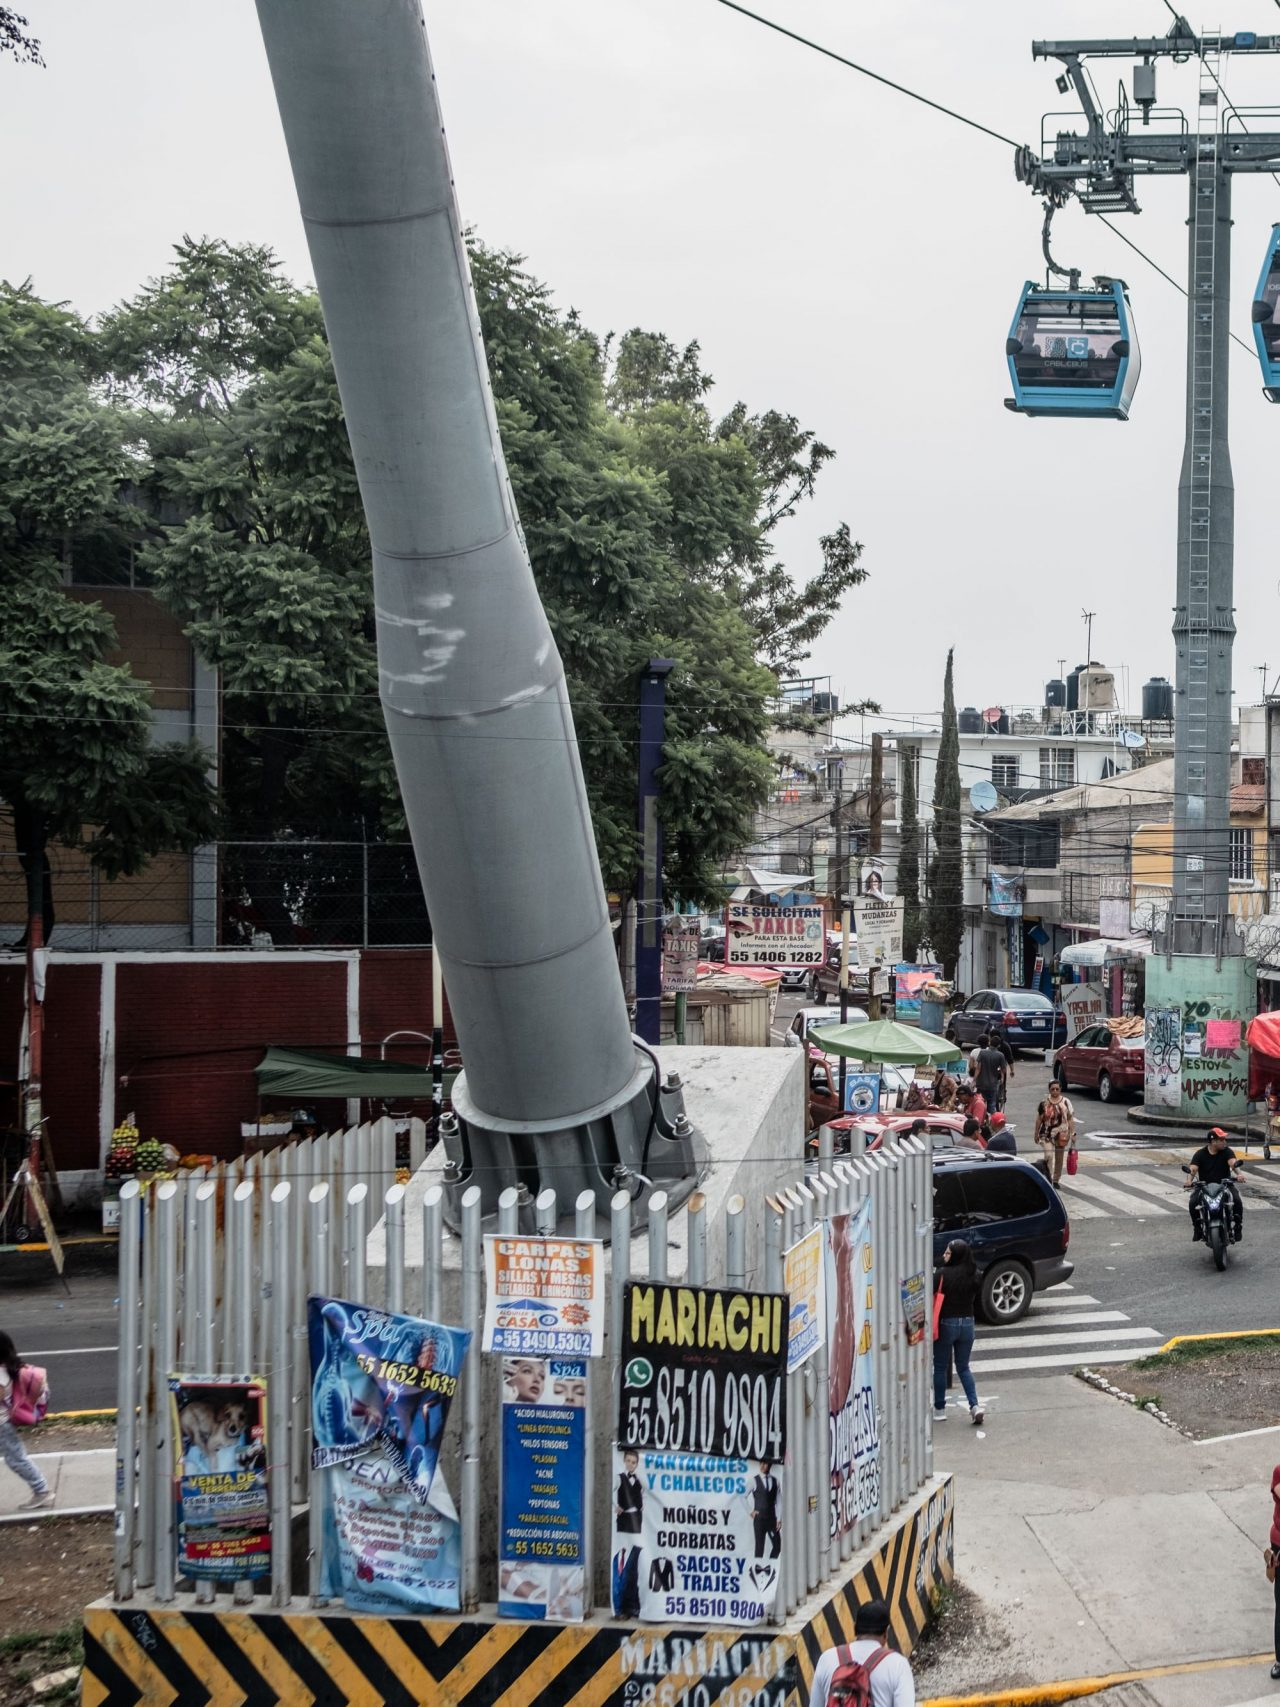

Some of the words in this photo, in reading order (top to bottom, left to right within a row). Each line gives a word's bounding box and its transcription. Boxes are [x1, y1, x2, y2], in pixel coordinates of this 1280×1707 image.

[732, 906, 748, 918] SE
[752, 906, 820, 918] SOLICITAN
[862, 910, 897, 920] MUDANZAS
[752, 918, 806, 934] TAXIS
[667, 940, 698, 952] TAXIS
[730, 951, 749, 962] 55
[753, 951, 786, 962] 1406
[790, 952, 822, 962] 1282
[1186, 1060, 1222, 1070] ESTOY
[849, 1076, 878, 1088] BASE
[498, 1243, 590, 1258] CARPAS
[508, 1256, 580, 1272] LONAS
[498, 1270, 538, 1283] SILLAS
[540, 1271, 548, 1284] Y
[550, 1272, 592, 1286] MESAS
[350, 1309, 400, 1344] Spa
[496, 1316, 539, 1328] CASA
[632, 1286, 782, 1354] MARIACHI
[503, 1330, 520, 1347] 55
[522, 1331, 590, 1350] 3490.5302
[378, 1360, 418, 1386] 1652
[420, 1371, 457, 1396] 5633
[552, 1361, 582, 1380] Spa
[627, 1397, 651, 1446] 55
[654, 1366, 716, 1453] 8510
[723, 1372, 782, 1459] 9804
[644, 1454, 748, 1473] PANTALONES
[190, 1474, 234, 1487] VENTA
[237, 1472, 256, 1482] DE
[647, 1474, 656, 1490] Y
[661, 1474, 746, 1494] CHALECOS
[663, 1505, 718, 1526] MOÑOS
[721, 1510, 731, 1526] Y
[516, 1541, 527, 1554] 55
[531, 1542, 553, 1555] 1652
[556, 1544, 578, 1556] 5633
[657, 1531, 736, 1551] CORBATAS
[677, 1555, 731, 1574] SACOS
[736, 1558, 746, 1575] Y
[681, 1574, 740, 1593] TRAJES
[666, 1597, 686, 1615] 55
[690, 1598, 726, 1617] 8510
[731, 1600, 765, 1620] 9804
[620, 1636, 788, 1680] MARIACHI
